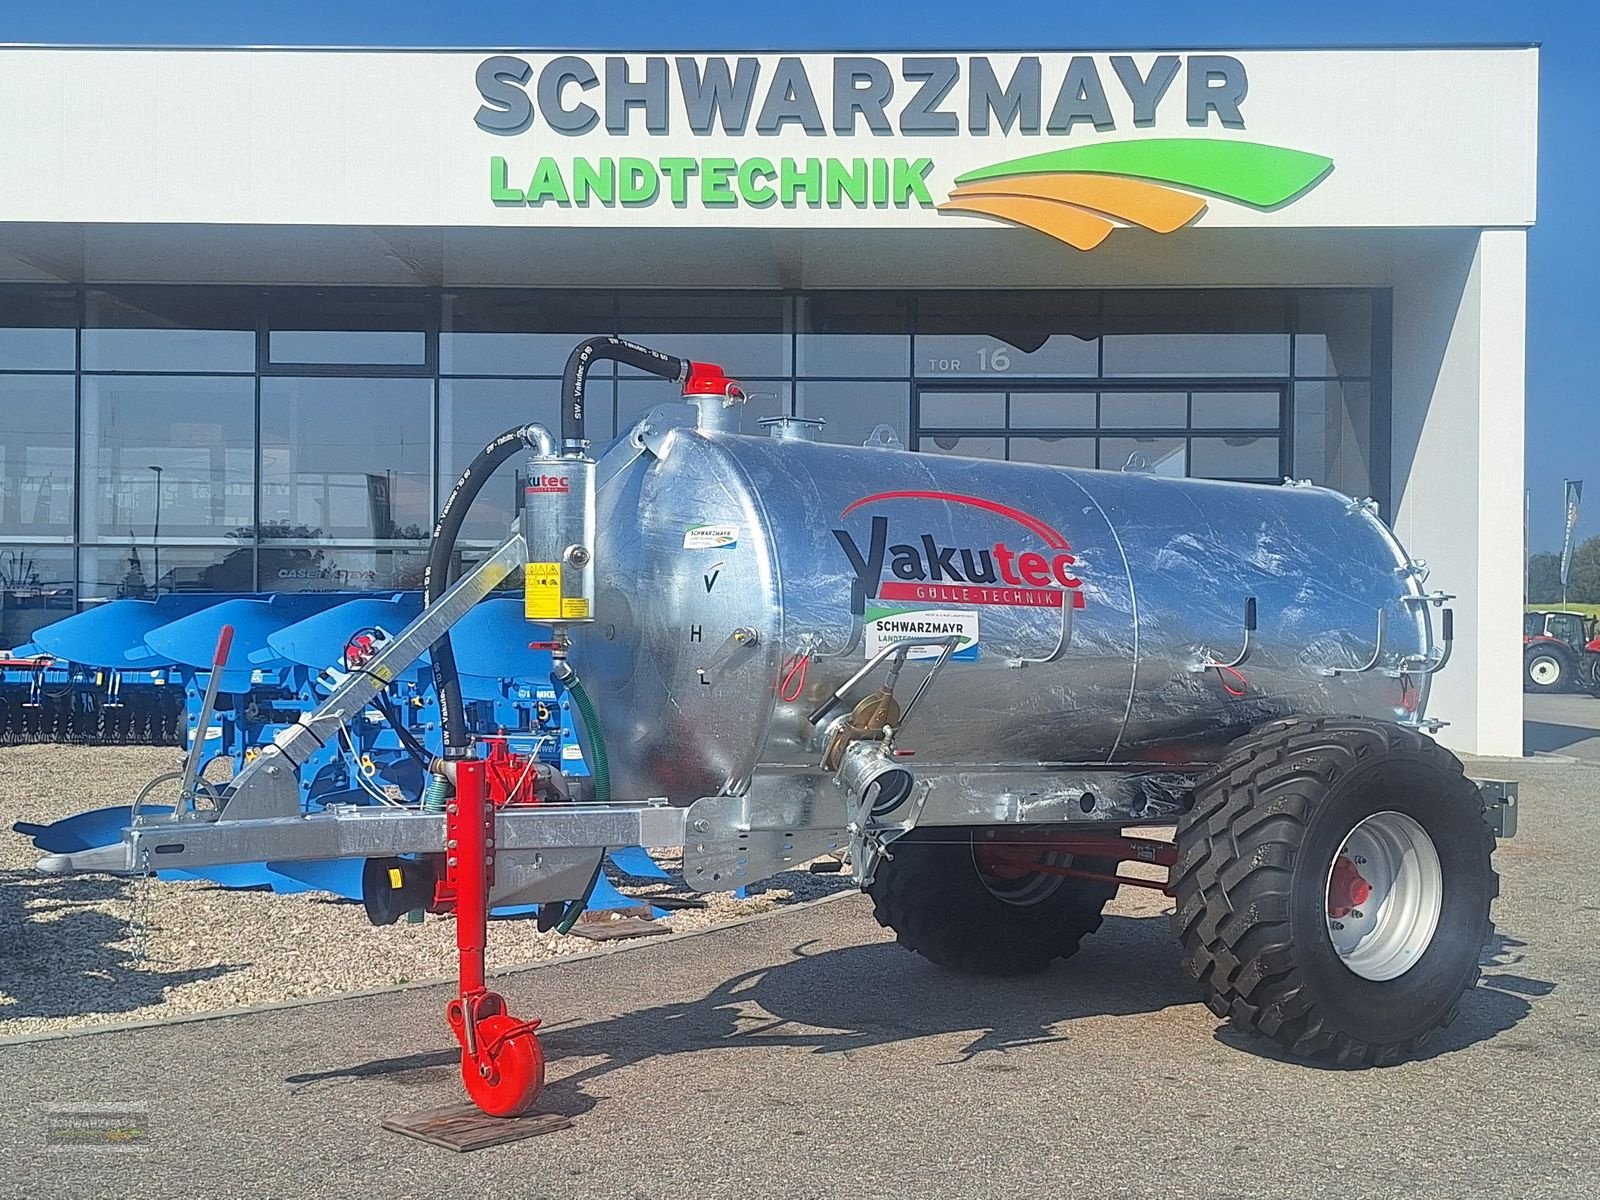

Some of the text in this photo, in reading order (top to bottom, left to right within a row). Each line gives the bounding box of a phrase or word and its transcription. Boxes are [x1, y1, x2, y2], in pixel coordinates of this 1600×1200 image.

[474, 53, 1247, 136] SCHWARZMAYR
[490, 156, 939, 208] LANDTECHNIK
[928, 347, 1011, 371] TOR 16
[574, 364, 584, 397] Vakutec
[574, 403, 582, 420] SW
[832, 516, 1083, 600] Vakutec
[278, 568, 316, 579] CASE
[690, 624, 703, 643] H
[876, 620, 965, 634] SCHWARZMAYR
[700, 667, 711, 685] L
[439, 687, 450, 723] Vakutec
